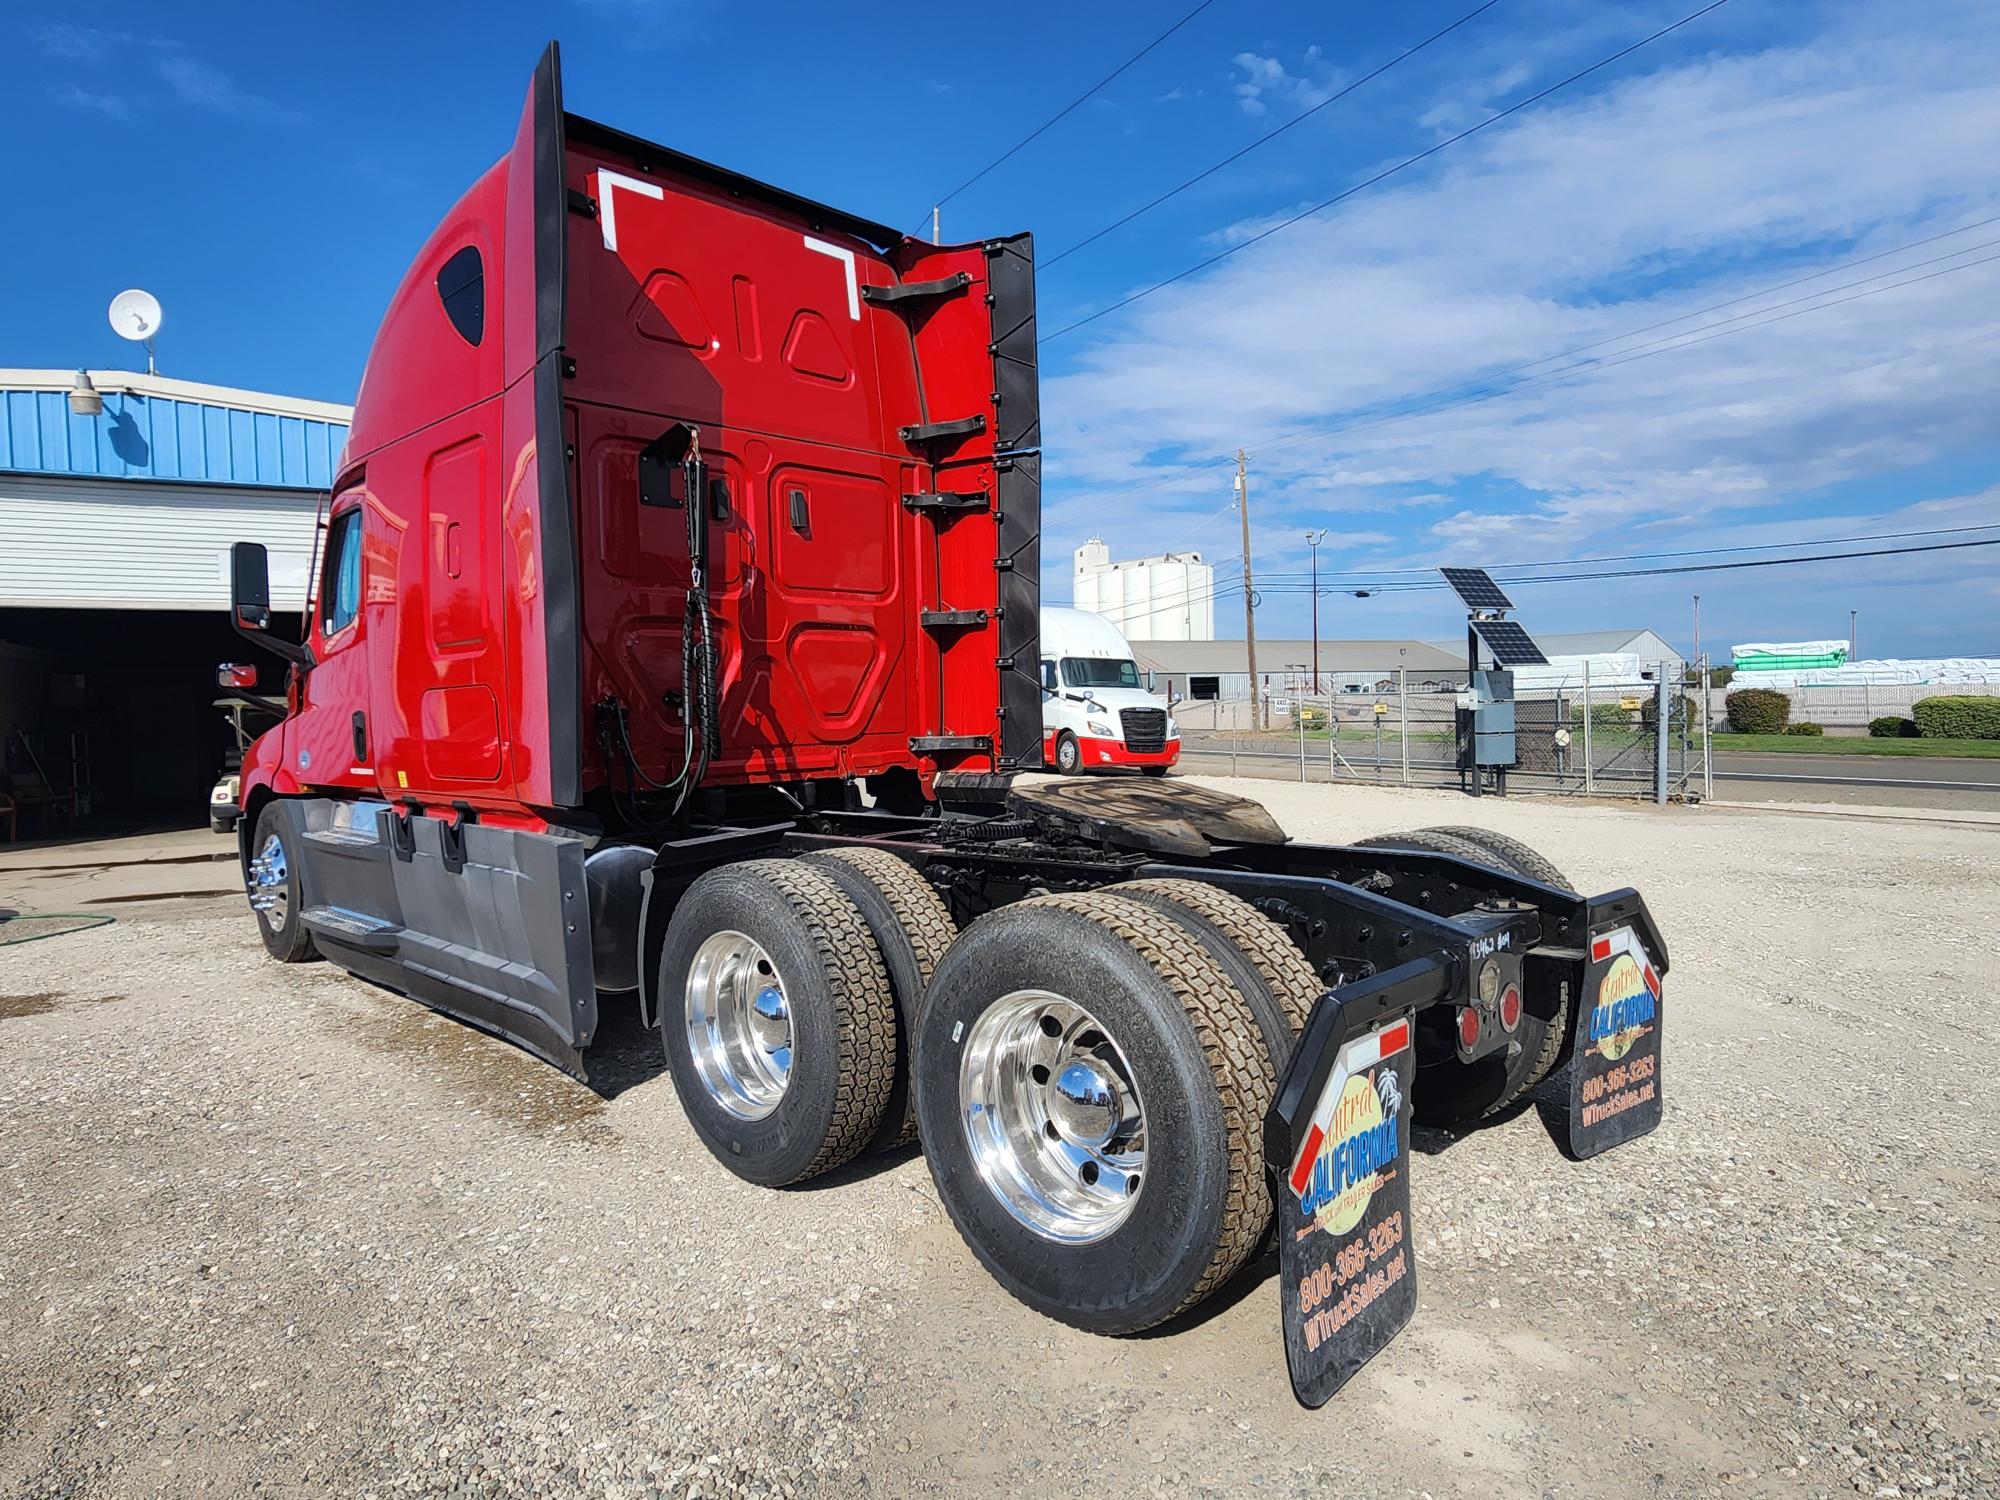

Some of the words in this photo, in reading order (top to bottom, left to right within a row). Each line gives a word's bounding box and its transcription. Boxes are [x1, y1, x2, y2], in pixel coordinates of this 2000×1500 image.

[1590, 989, 1655, 1041] CALIFORNIA
[1582, 1054, 1655, 1103] 800-366-3263
[1582, 1080, 1655, 1128] WTruckSales.net
[1321, 1068, 1376, 1151] entral
[1313, 1208, 1334, 1232] TRUCK
[1343, 1186, 1367, 1208] TRAILER
[1366, 1173, 1385, 1196] SALES
[1300, 1210, 1403, 1313] 800-366-3263
[1304, 1248, 1407, 1353] WTruckSales.net
